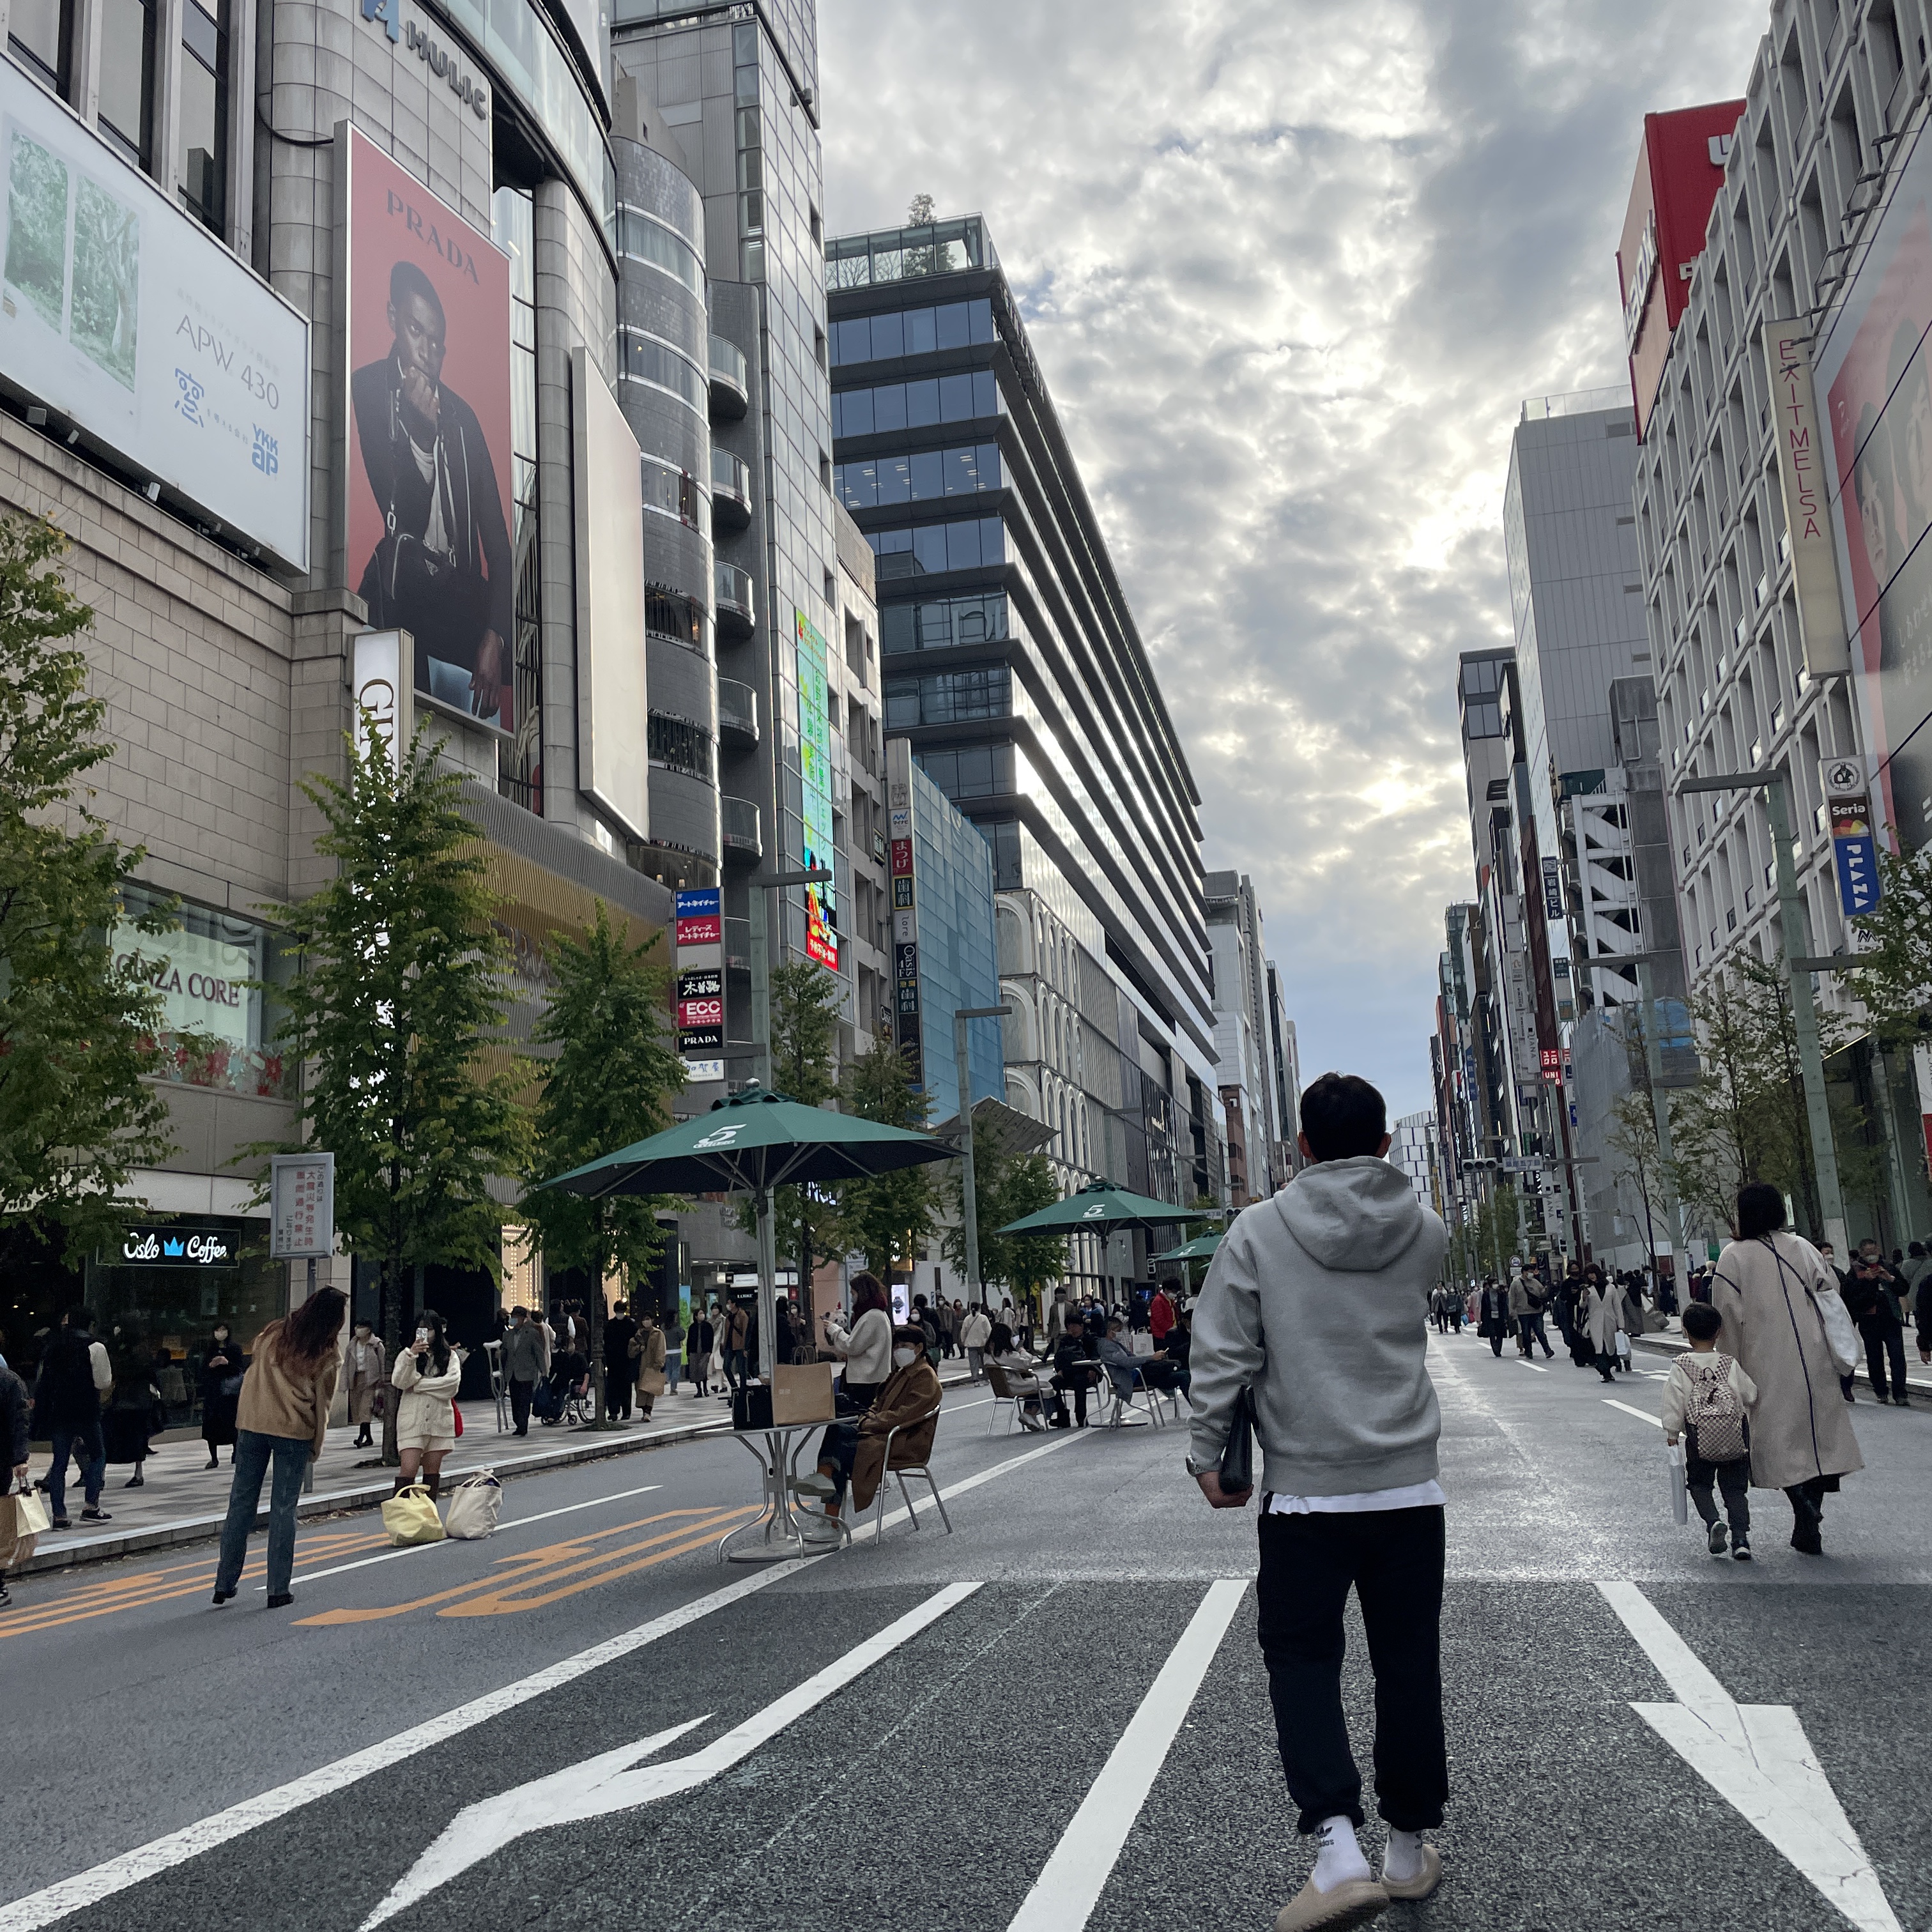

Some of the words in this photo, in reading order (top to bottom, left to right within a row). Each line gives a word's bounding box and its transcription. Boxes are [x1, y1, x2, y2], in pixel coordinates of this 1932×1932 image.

[407, 20, 486, 120] HULIC
[387, 188, 480, 286] PRADA
[176, 314, 234, 372] APW
[241, 364, 279, 410] 430
[252, 422, 279, 456] YKK
[1779, 339, 1821, 540] EXITMELSA
[252, 441, 279, 476] ap
[1832, 803, 1866, 816] Seria
[896, 841, 908, 868] まつげ
[1846, 844, 1869, 908] PLAZA
[677, 900, 719, 908] アートネイチャー
[898, 879, 910, 906] 歯科
[678, 931, 719, 940] アートネイチャー
[685, 924, 712, 933] レディース
[903, 946, 916, 977] Oasis
[188, 973, 240, 1008] CORE
[686, 1000, 720, 1016] ECC
[684, 1035, 717, 1045] PRADA
[1528, 1031, 1537, 1059] DIANA
[123, 1232, 160, 1259] Oslo
[187, 1235, 227, 1263] Coffee
